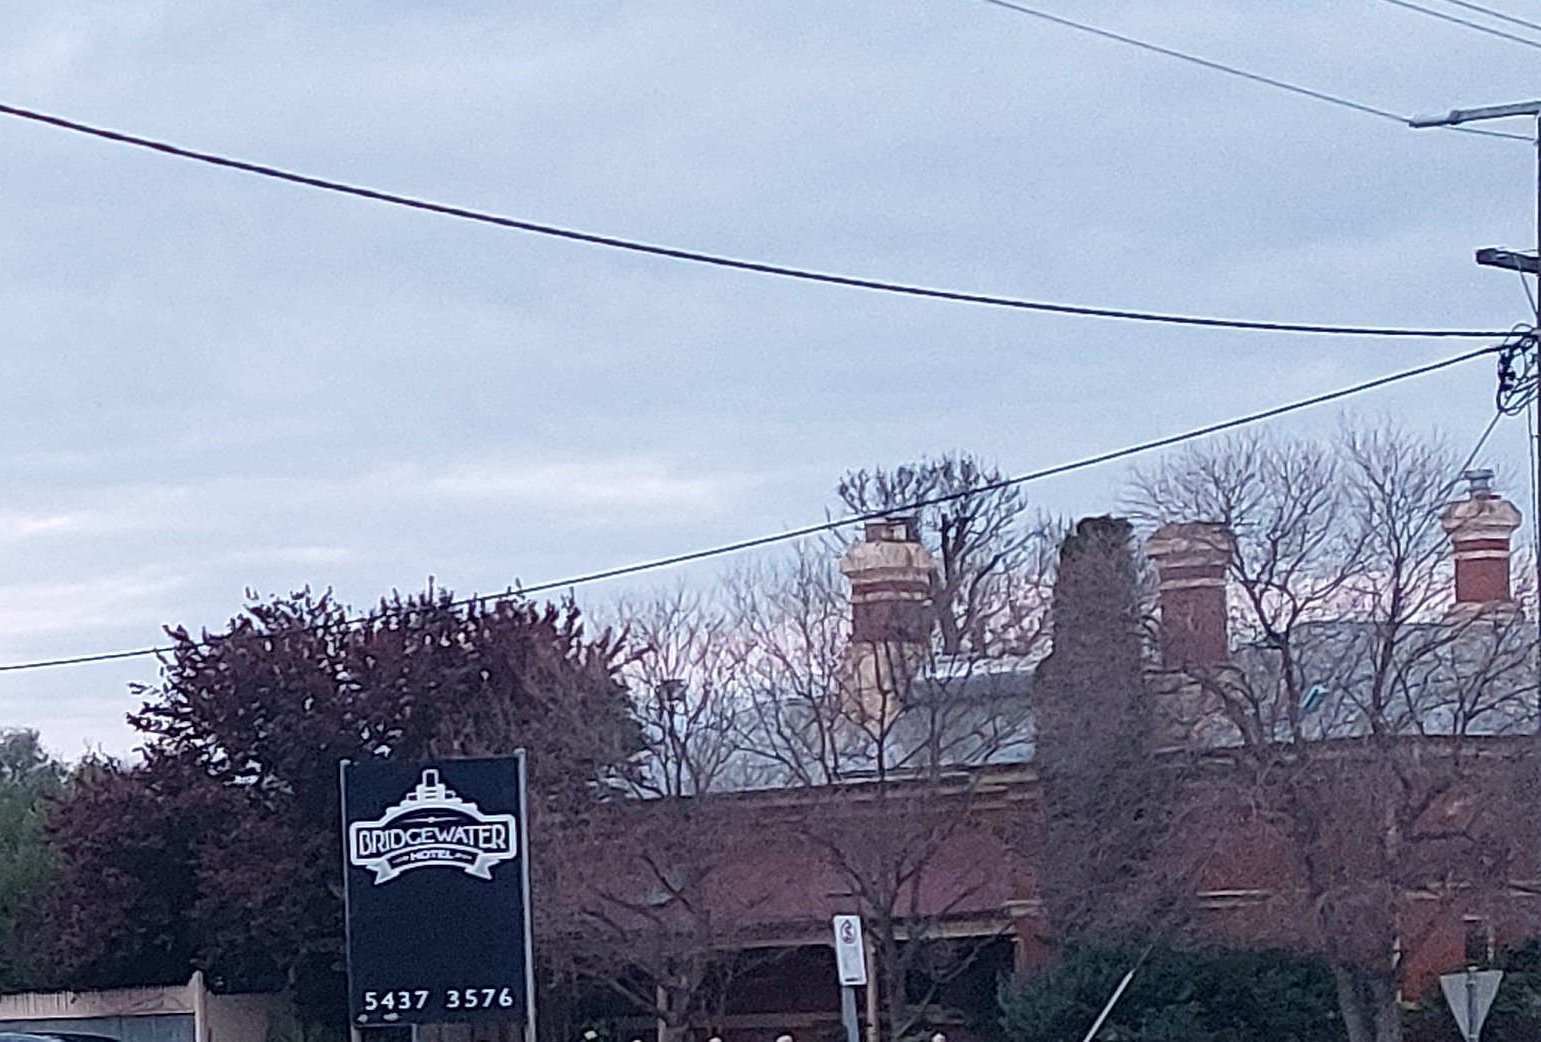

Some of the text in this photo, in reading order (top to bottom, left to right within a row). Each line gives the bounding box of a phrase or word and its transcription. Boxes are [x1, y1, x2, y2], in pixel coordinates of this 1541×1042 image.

[359, 824, 506, 856] BRIDGEWATER
[410, 850, 453, 860] HOTEL
[365, 988, 513, 1010] 5437 3576
